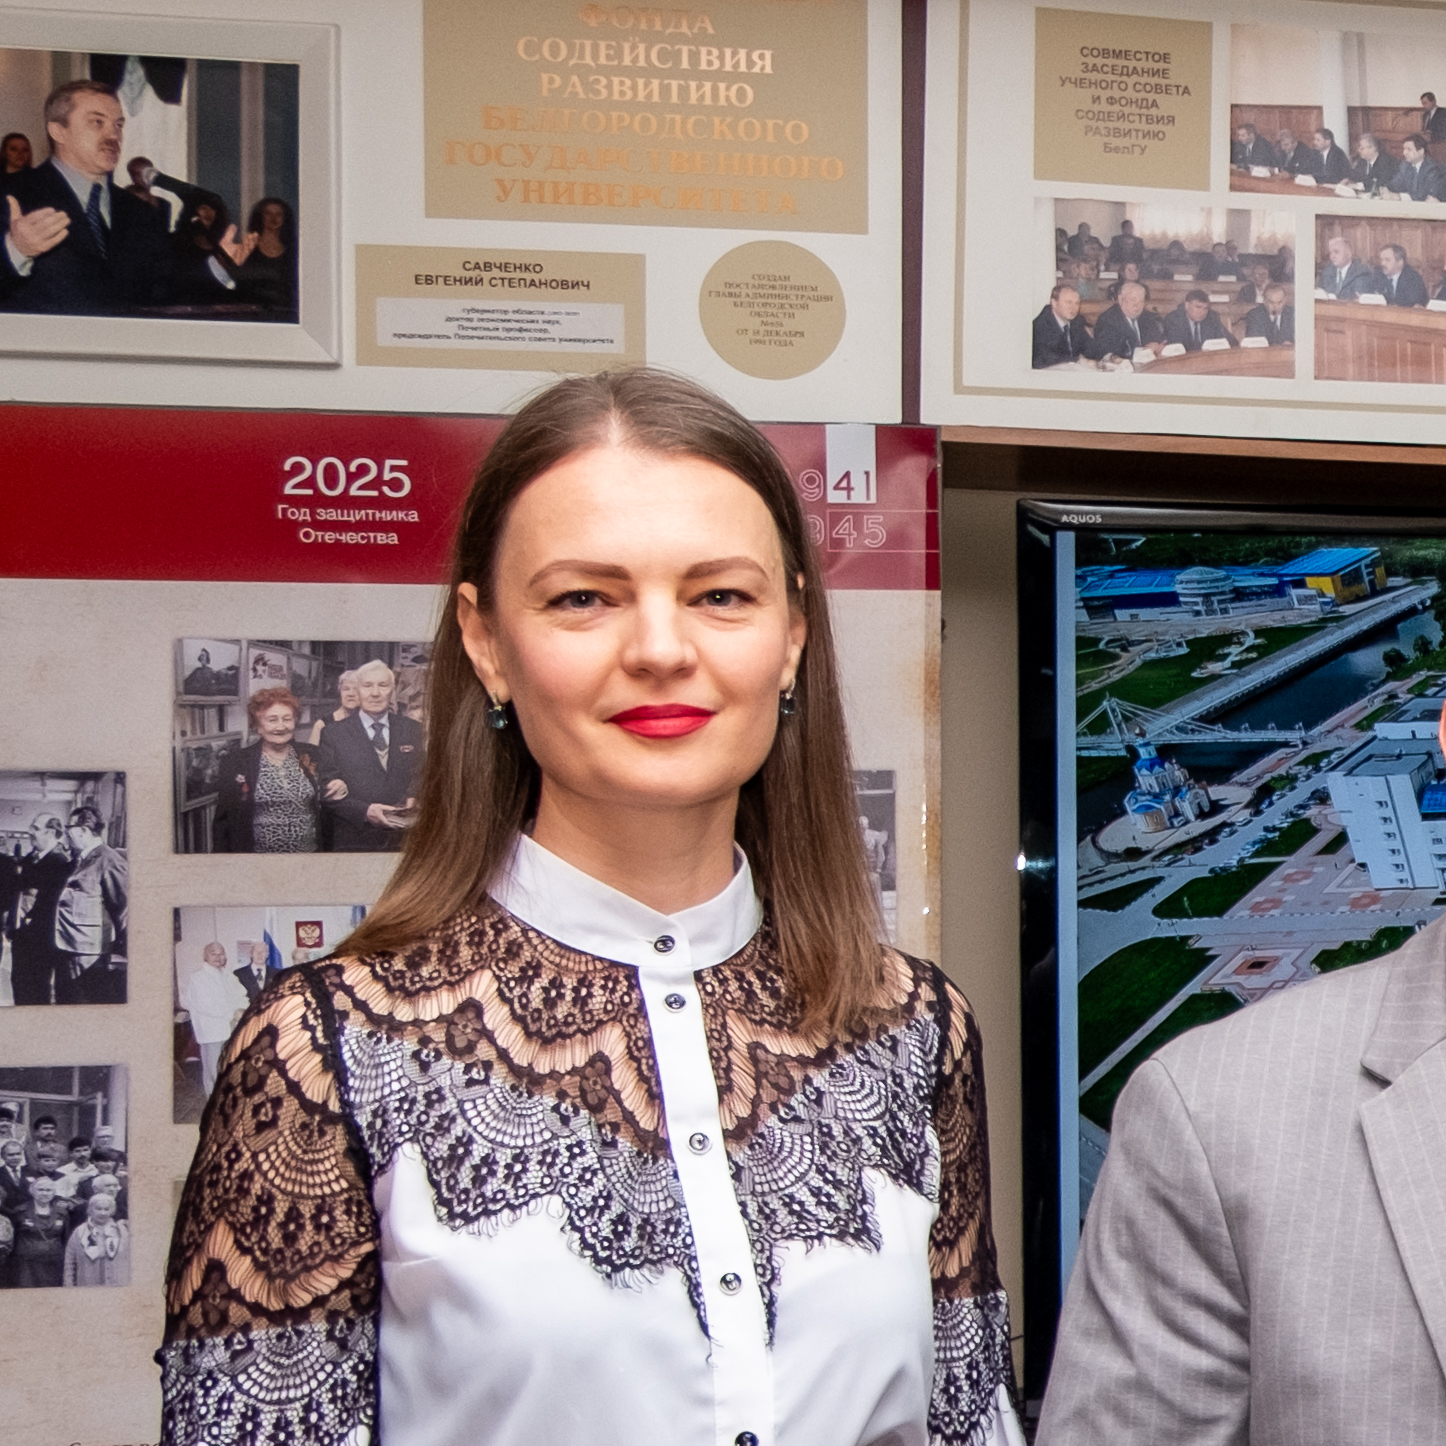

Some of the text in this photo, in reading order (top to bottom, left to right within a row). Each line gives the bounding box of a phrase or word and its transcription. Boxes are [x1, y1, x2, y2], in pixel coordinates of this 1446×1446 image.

[578, 3, 716, 37] ФОНДА
[516, 35, 775, 75] СОДЕЙСТВИЯ
[1079, 46, 1172, 64] СОВМЕСТОЕ
[1080, 62, 1171, 80] ЗАСЕДАНИЕ
[538, 72, 755, 109] РАЗВИТИЮ
[1059, 75, 1192, 97] УЧЕНОГО СОВЕТА
[1091, 94, 1160, 111] И ФОНДА
[480, 104, 811, 146] БЕЛГОРОДСКОГО
[1075, 109, 1176, 127] СОДЕЙСТВИЯ
[1084, 124, 1167, 141] РАЗВИТИЮ
[1102, 142, 1148, 156] БелГУ
[444, 139, 846, 182] ГОСУДАРСТВЕННОГО
[494, 176, 798, 216] УНИВЕРСИТЕТА
[462, 260, 544, 275] САВЧЕНКО
[413, 273, 591, 291] ЕВГЕНИЙ СТЕПАНОВИЧ
[283, 455, 412, 498] 2025
[277, 504, 420, 523] Год защитника
[1060, 514, 1102, 525] AQUOS
[299, 527, 400, 545] Отечества
